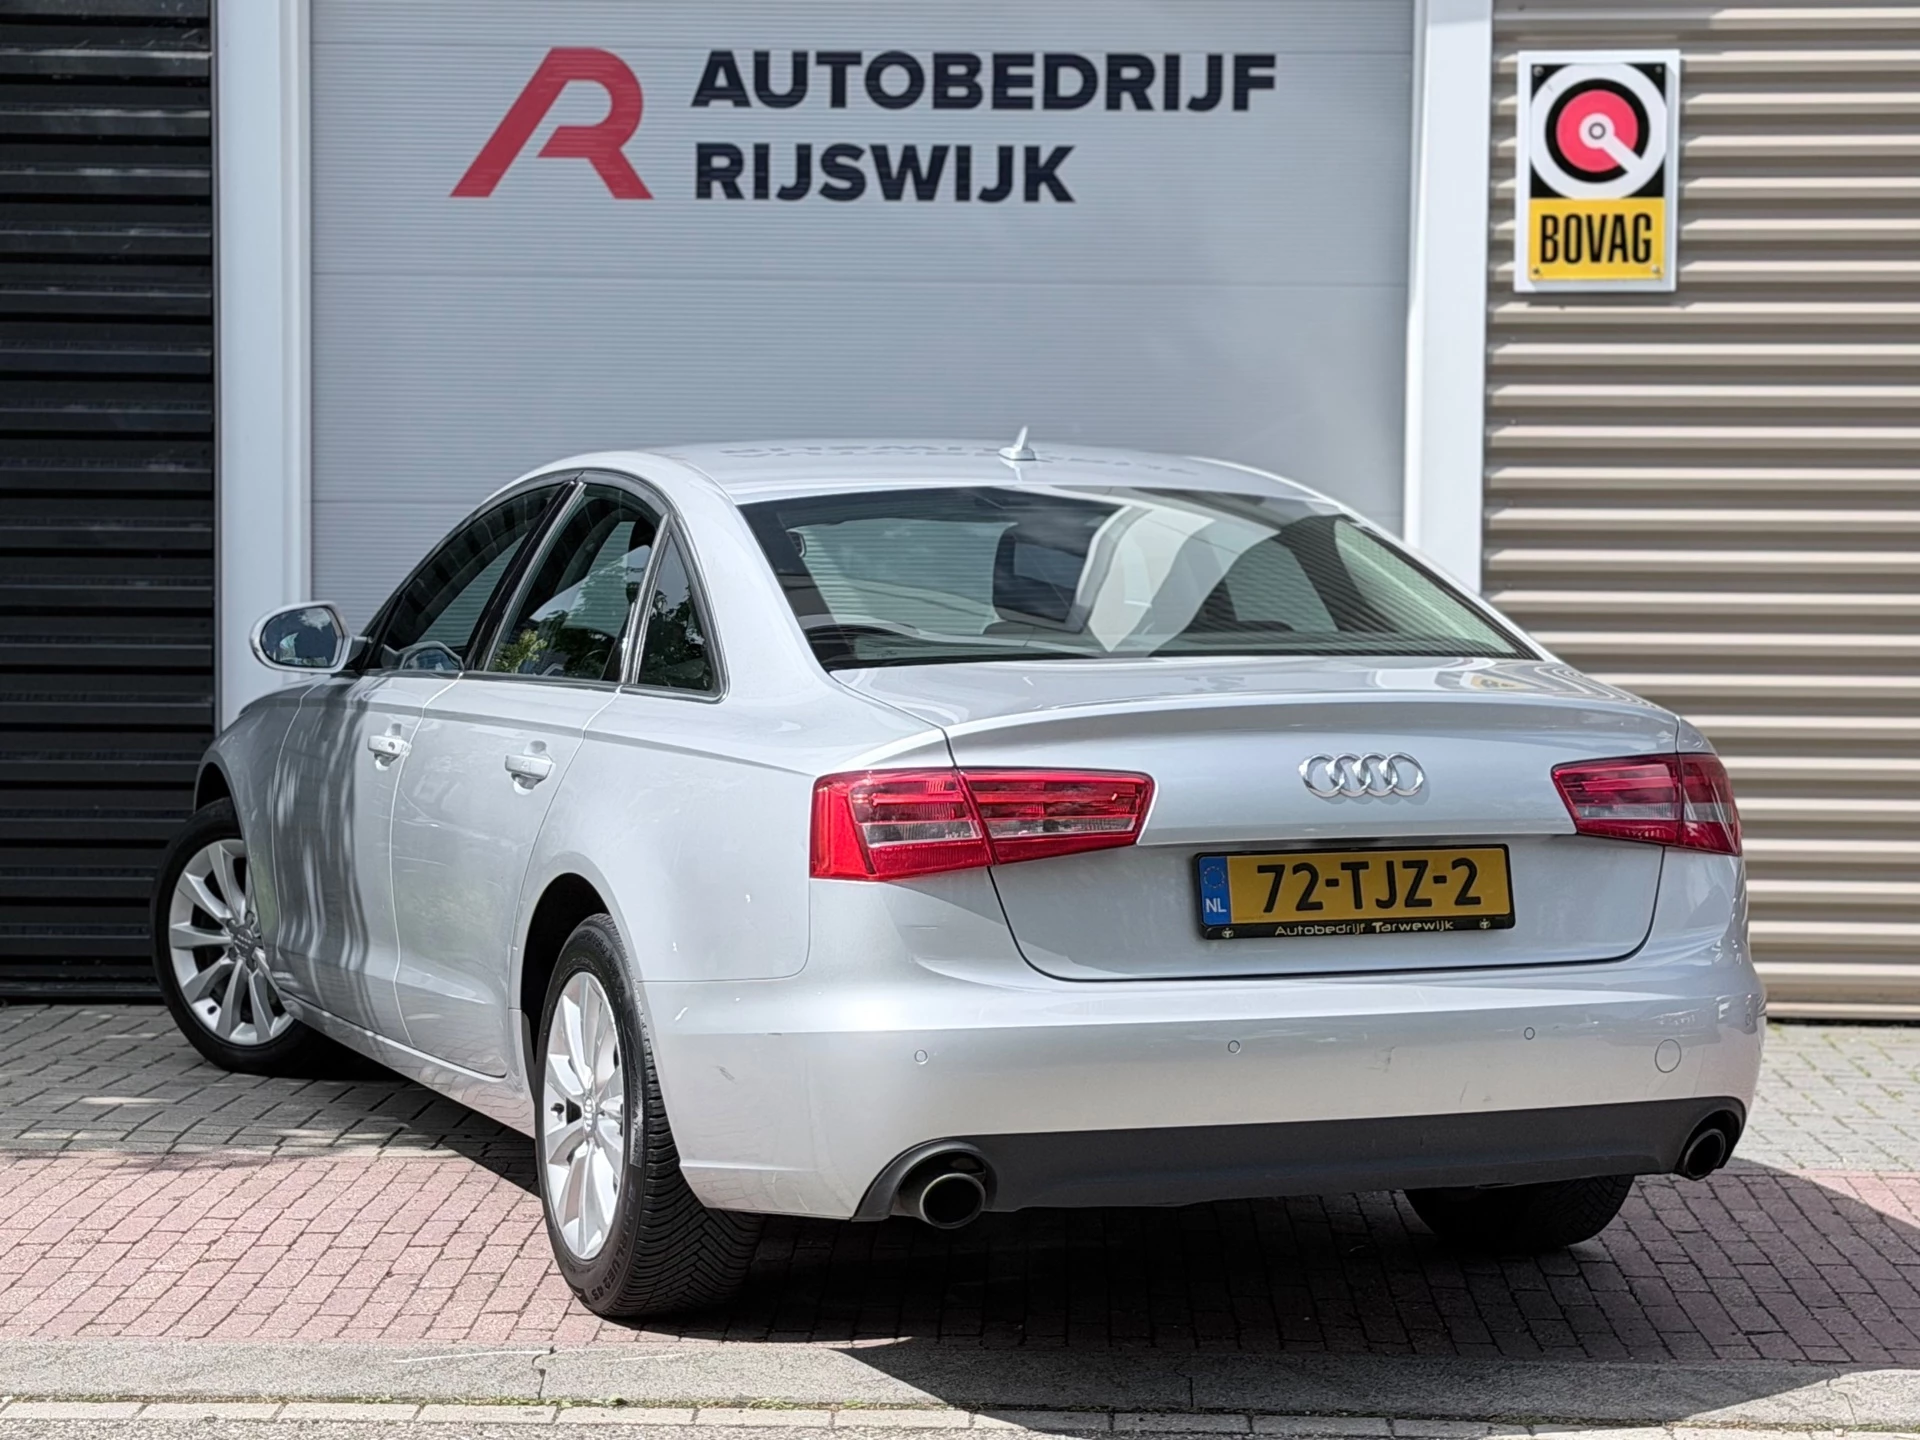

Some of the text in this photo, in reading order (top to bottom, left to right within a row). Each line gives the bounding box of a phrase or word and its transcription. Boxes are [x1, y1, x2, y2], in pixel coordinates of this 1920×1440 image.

[691, 50, 1277, 113] AUTOBEDRIJF
[695, 142, 1075, 203] RIJSWIJK
[1540, 213, 1652, 264] BOVAG
[1205, 898, 1227, 913] NL
[1256, 857, 1482, 914] 72-TJZ-2
[1274, 920, 1455, 937] Autobedrijf Tarwewijk
